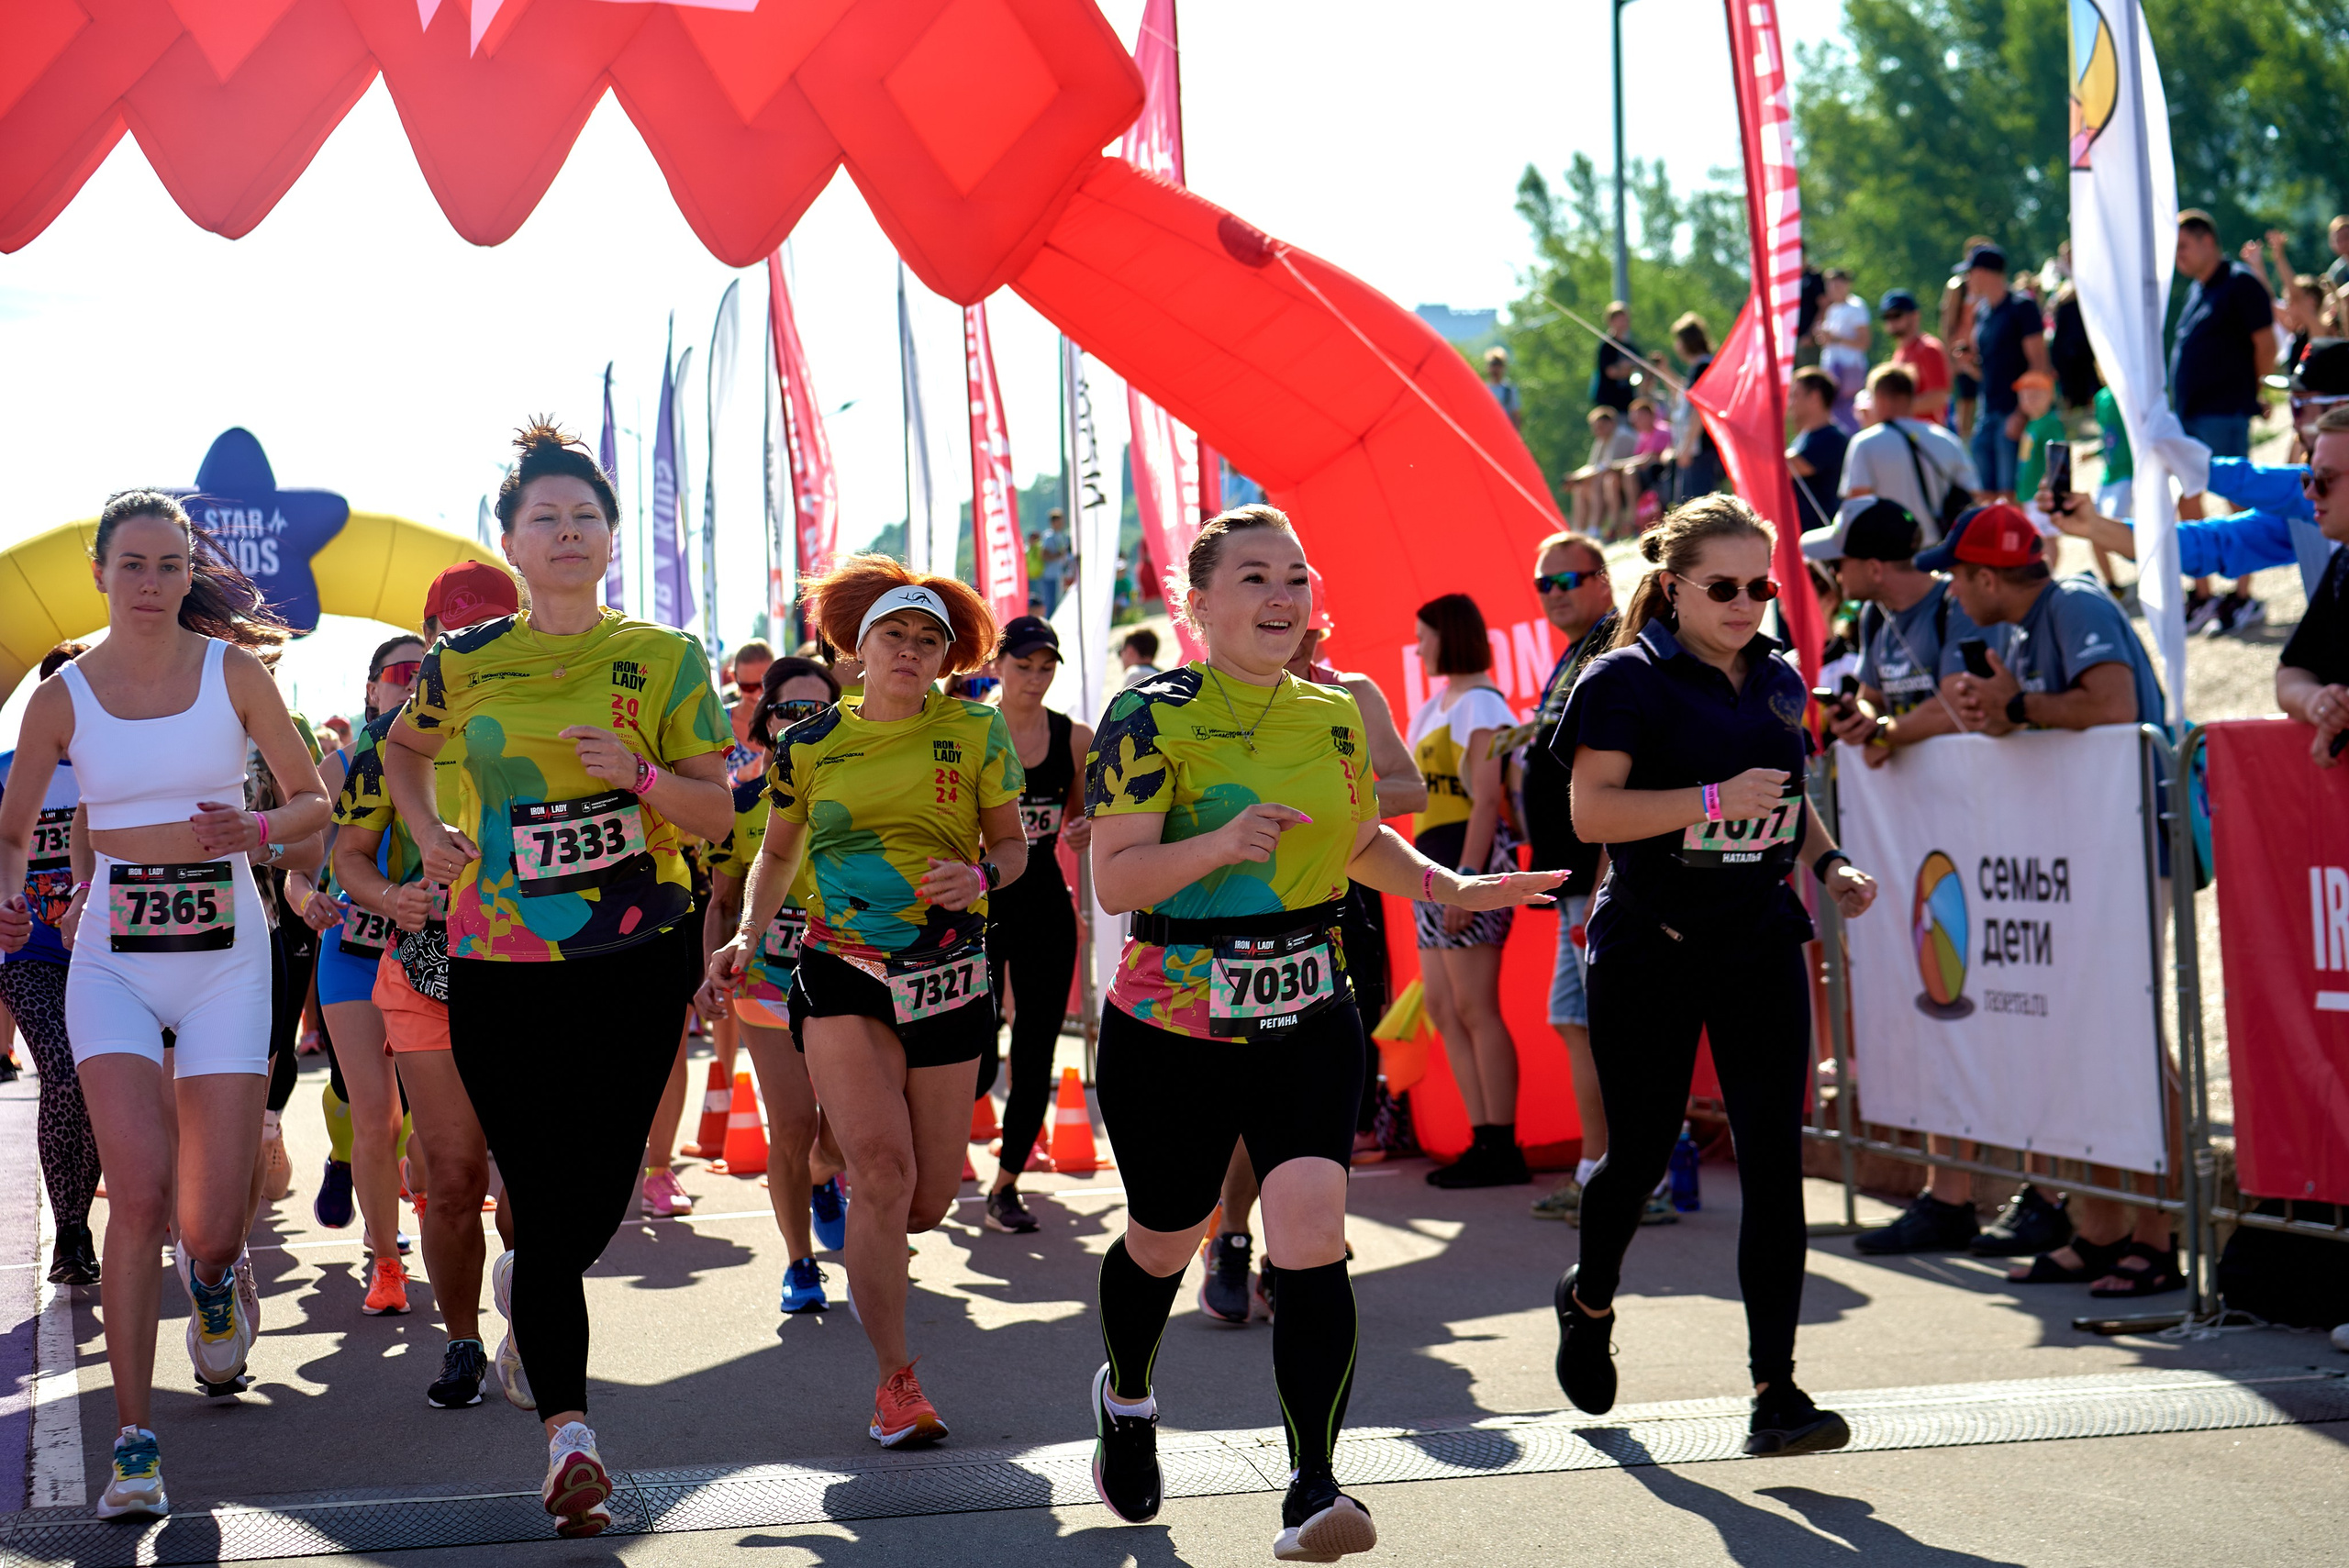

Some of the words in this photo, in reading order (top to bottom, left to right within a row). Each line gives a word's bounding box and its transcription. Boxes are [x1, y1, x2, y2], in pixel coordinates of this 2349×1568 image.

[204, 508, 264, 538] STAR
[613, 661, 639, 674] IRON
[612, 672, 647, 693] LADY
[611, 694, 640, 717] 20
[933, 740, 954, 750] IRON
[934, 750, 962, 763] LADY
[935, 768, 960, 784] 20
[935, 787, 958, 804] 24
[530, 807, 545, 816] IRON
[551, 804, 567, 813] LADY
[33, 826, 71, 852] 733
[532, 818, 626, 867] 7333
[1722, 852, 1763, 862] НАТАЛЬЯ
[127, 889, 217, 925] 7365
[1234, 940, 1250, 950] IRON
[1257, 940, 1275, 950] LADY
[907, 962, 974, 1010] 7327
[1229, 957, 1319, 1006] 7030
[1260, 1015, 1297, 1029] РЕГИНА
